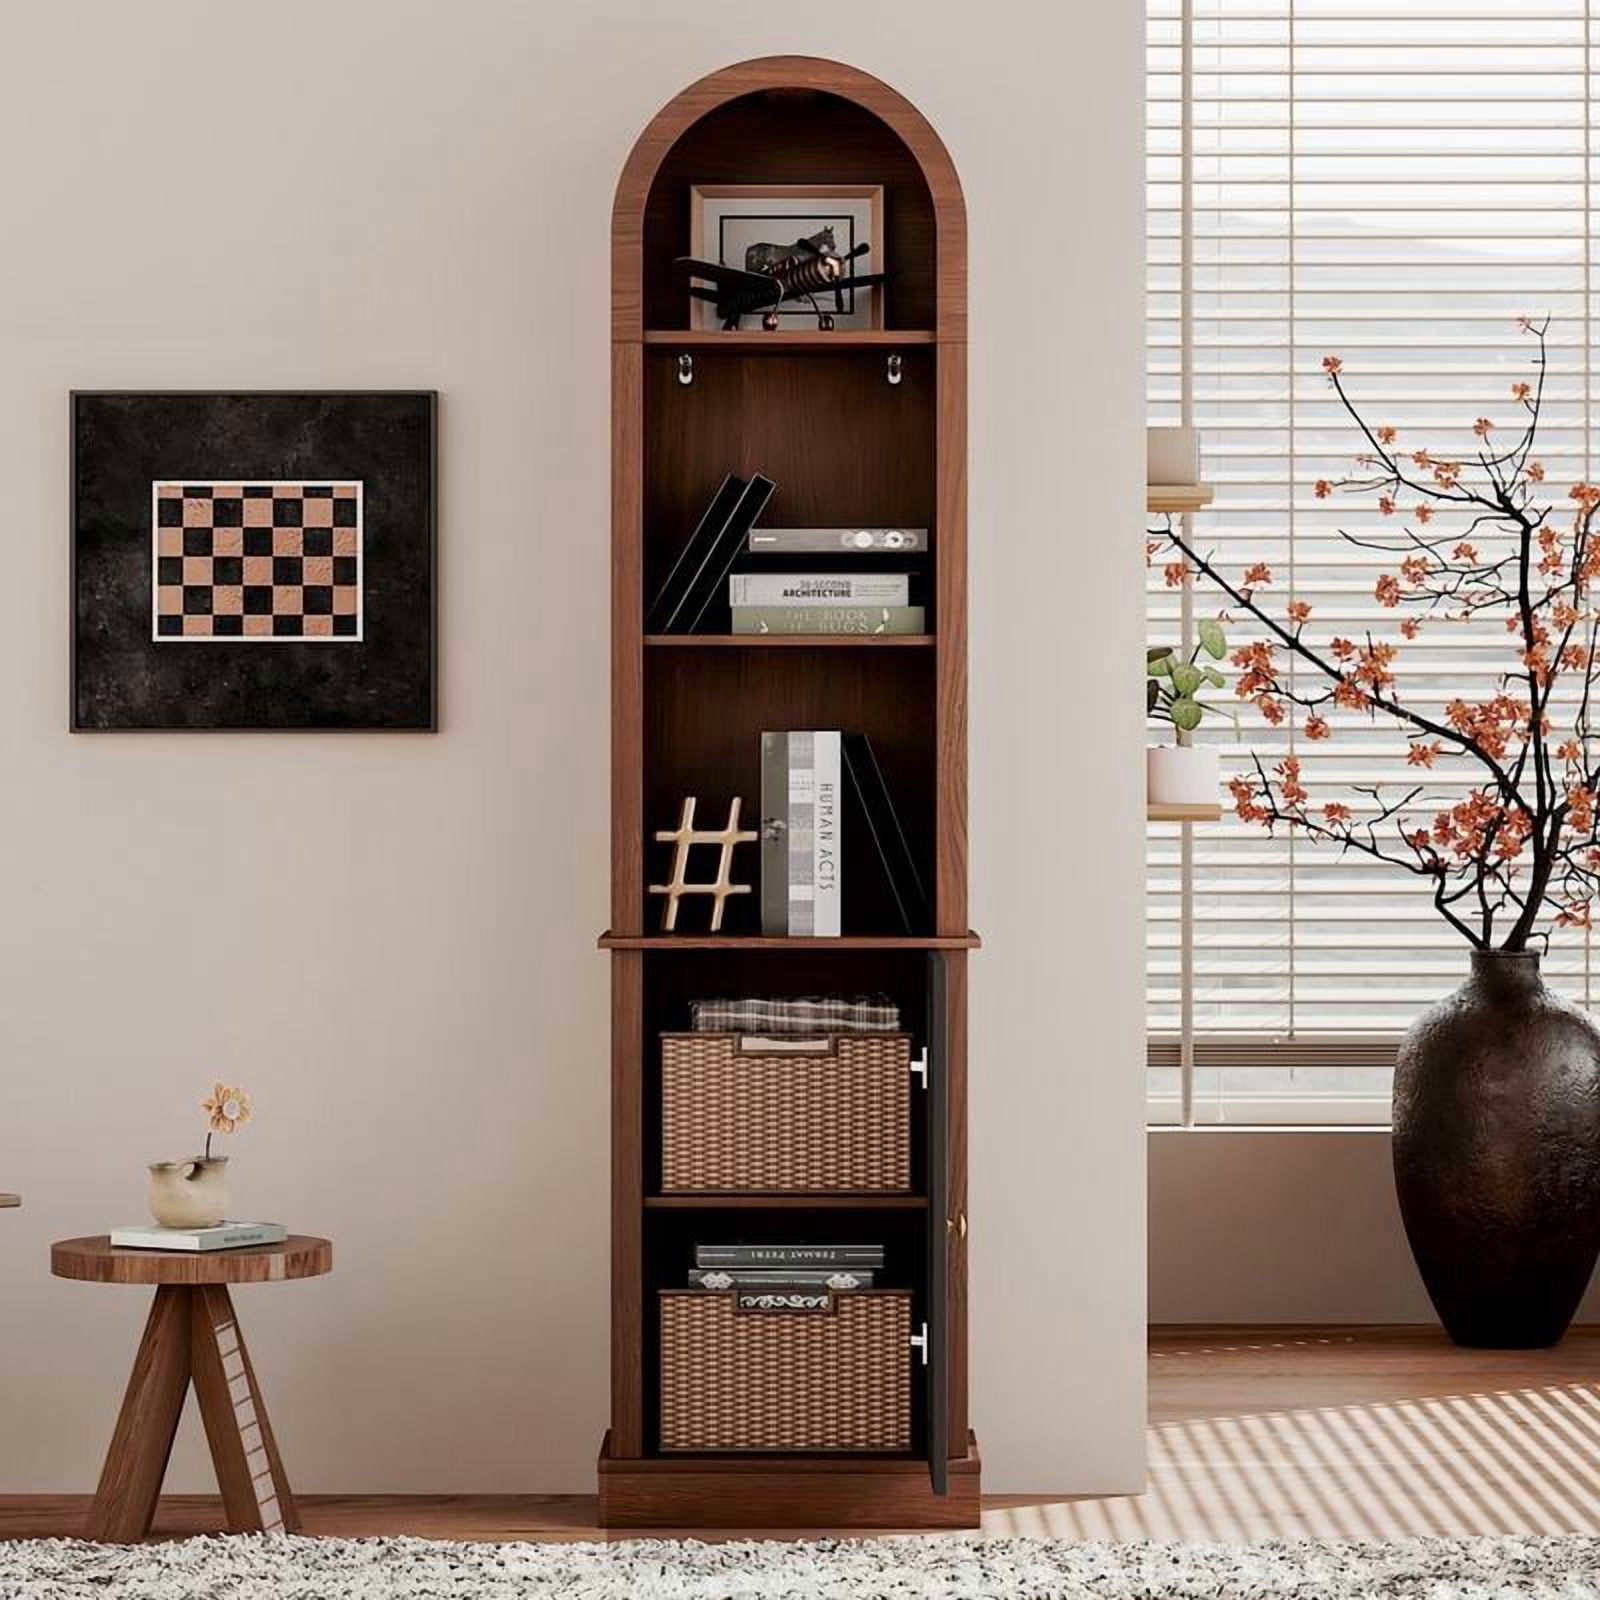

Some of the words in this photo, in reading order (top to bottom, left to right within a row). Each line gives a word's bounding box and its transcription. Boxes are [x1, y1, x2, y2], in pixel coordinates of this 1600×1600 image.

[783, 588, 852, 598] ARCHITECTURE
[819, 783, 833, 840] HUMAN
[819, 848, 834, 890] ACTS
